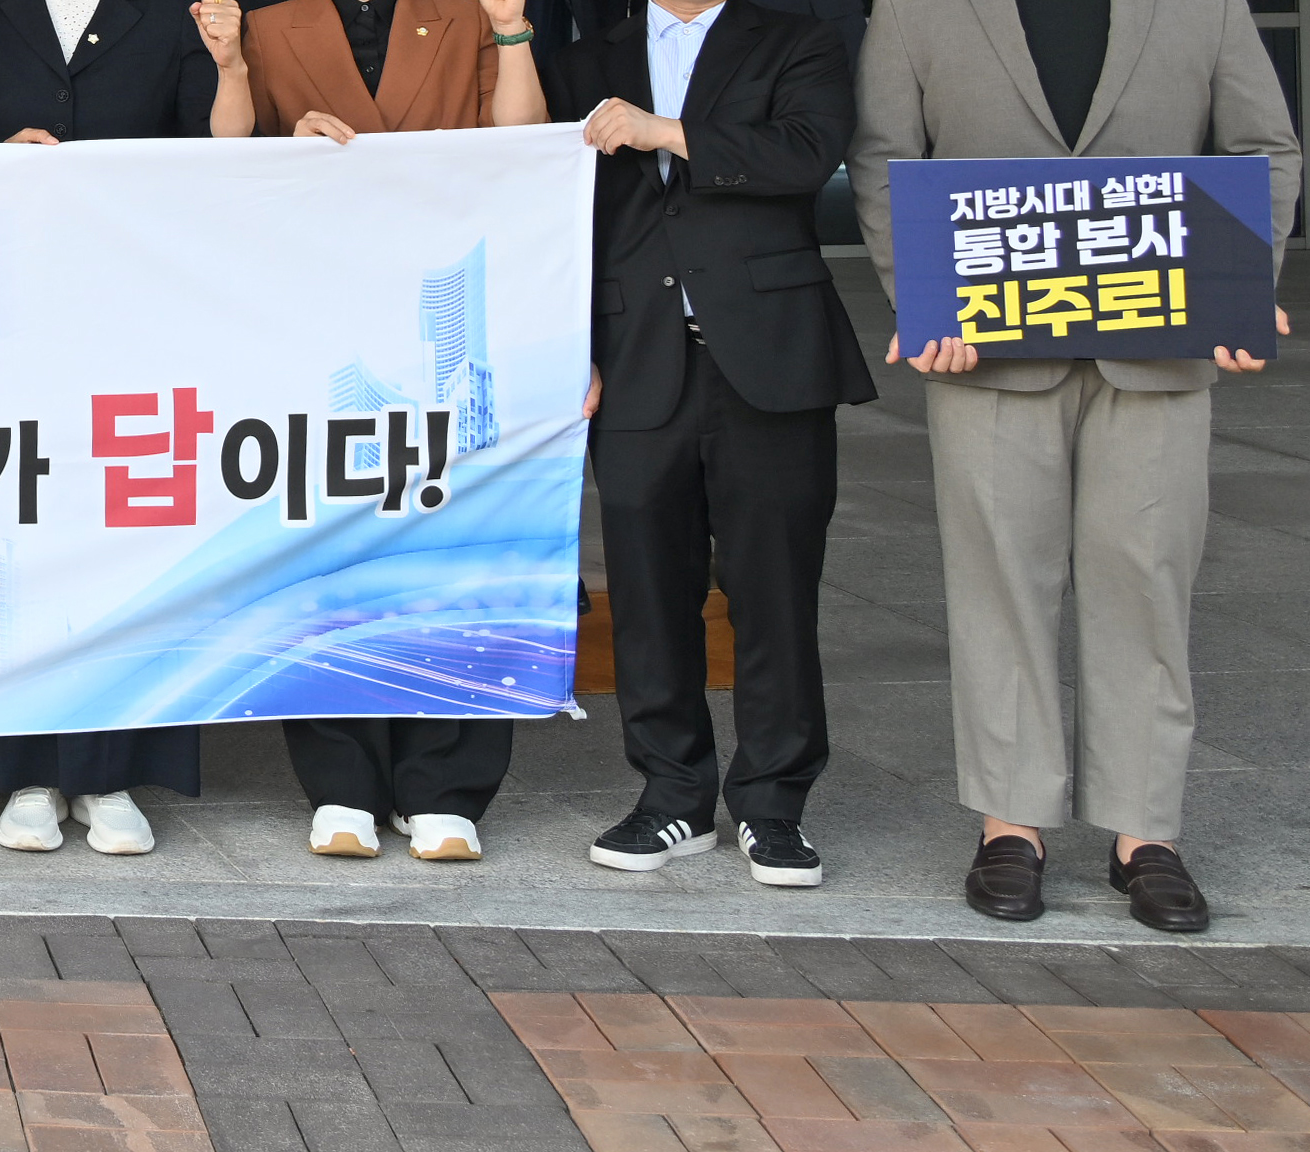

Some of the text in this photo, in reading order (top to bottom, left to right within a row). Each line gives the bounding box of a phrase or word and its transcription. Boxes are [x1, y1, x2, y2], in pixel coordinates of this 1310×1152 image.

[950, 172, 1183, 221] 지방시대 실현!
[954, 210, 1187, 275] 통합 본사
[955, 267, 1186, 345] 진주로!
[89, 387, 452, 528] 답이다!
